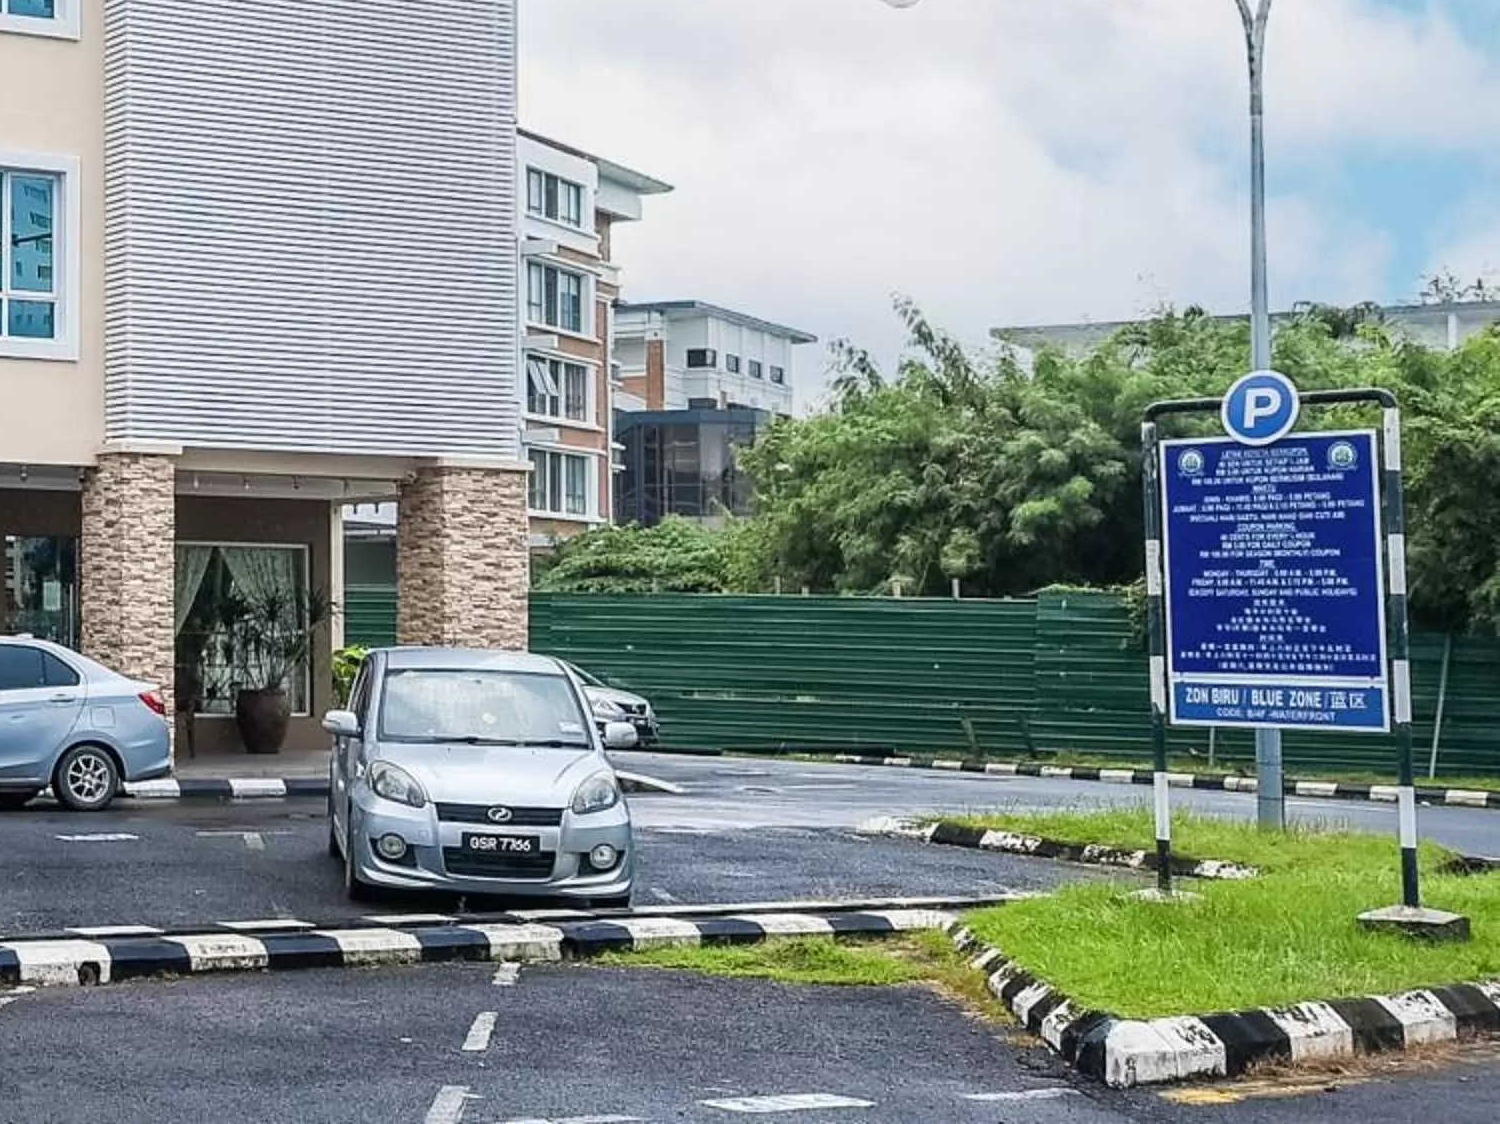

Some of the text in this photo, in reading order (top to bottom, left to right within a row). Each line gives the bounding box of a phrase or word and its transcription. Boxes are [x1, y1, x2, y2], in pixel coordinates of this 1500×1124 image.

[1243, 387, 1281, 429] P
[1185, 687, 1209, 704] ZON
[1211, 687, 1239, 705] BIRU
[1251, 688, 1283, 706] BLUE
[1289, 690, 1322, 708] ZONE
